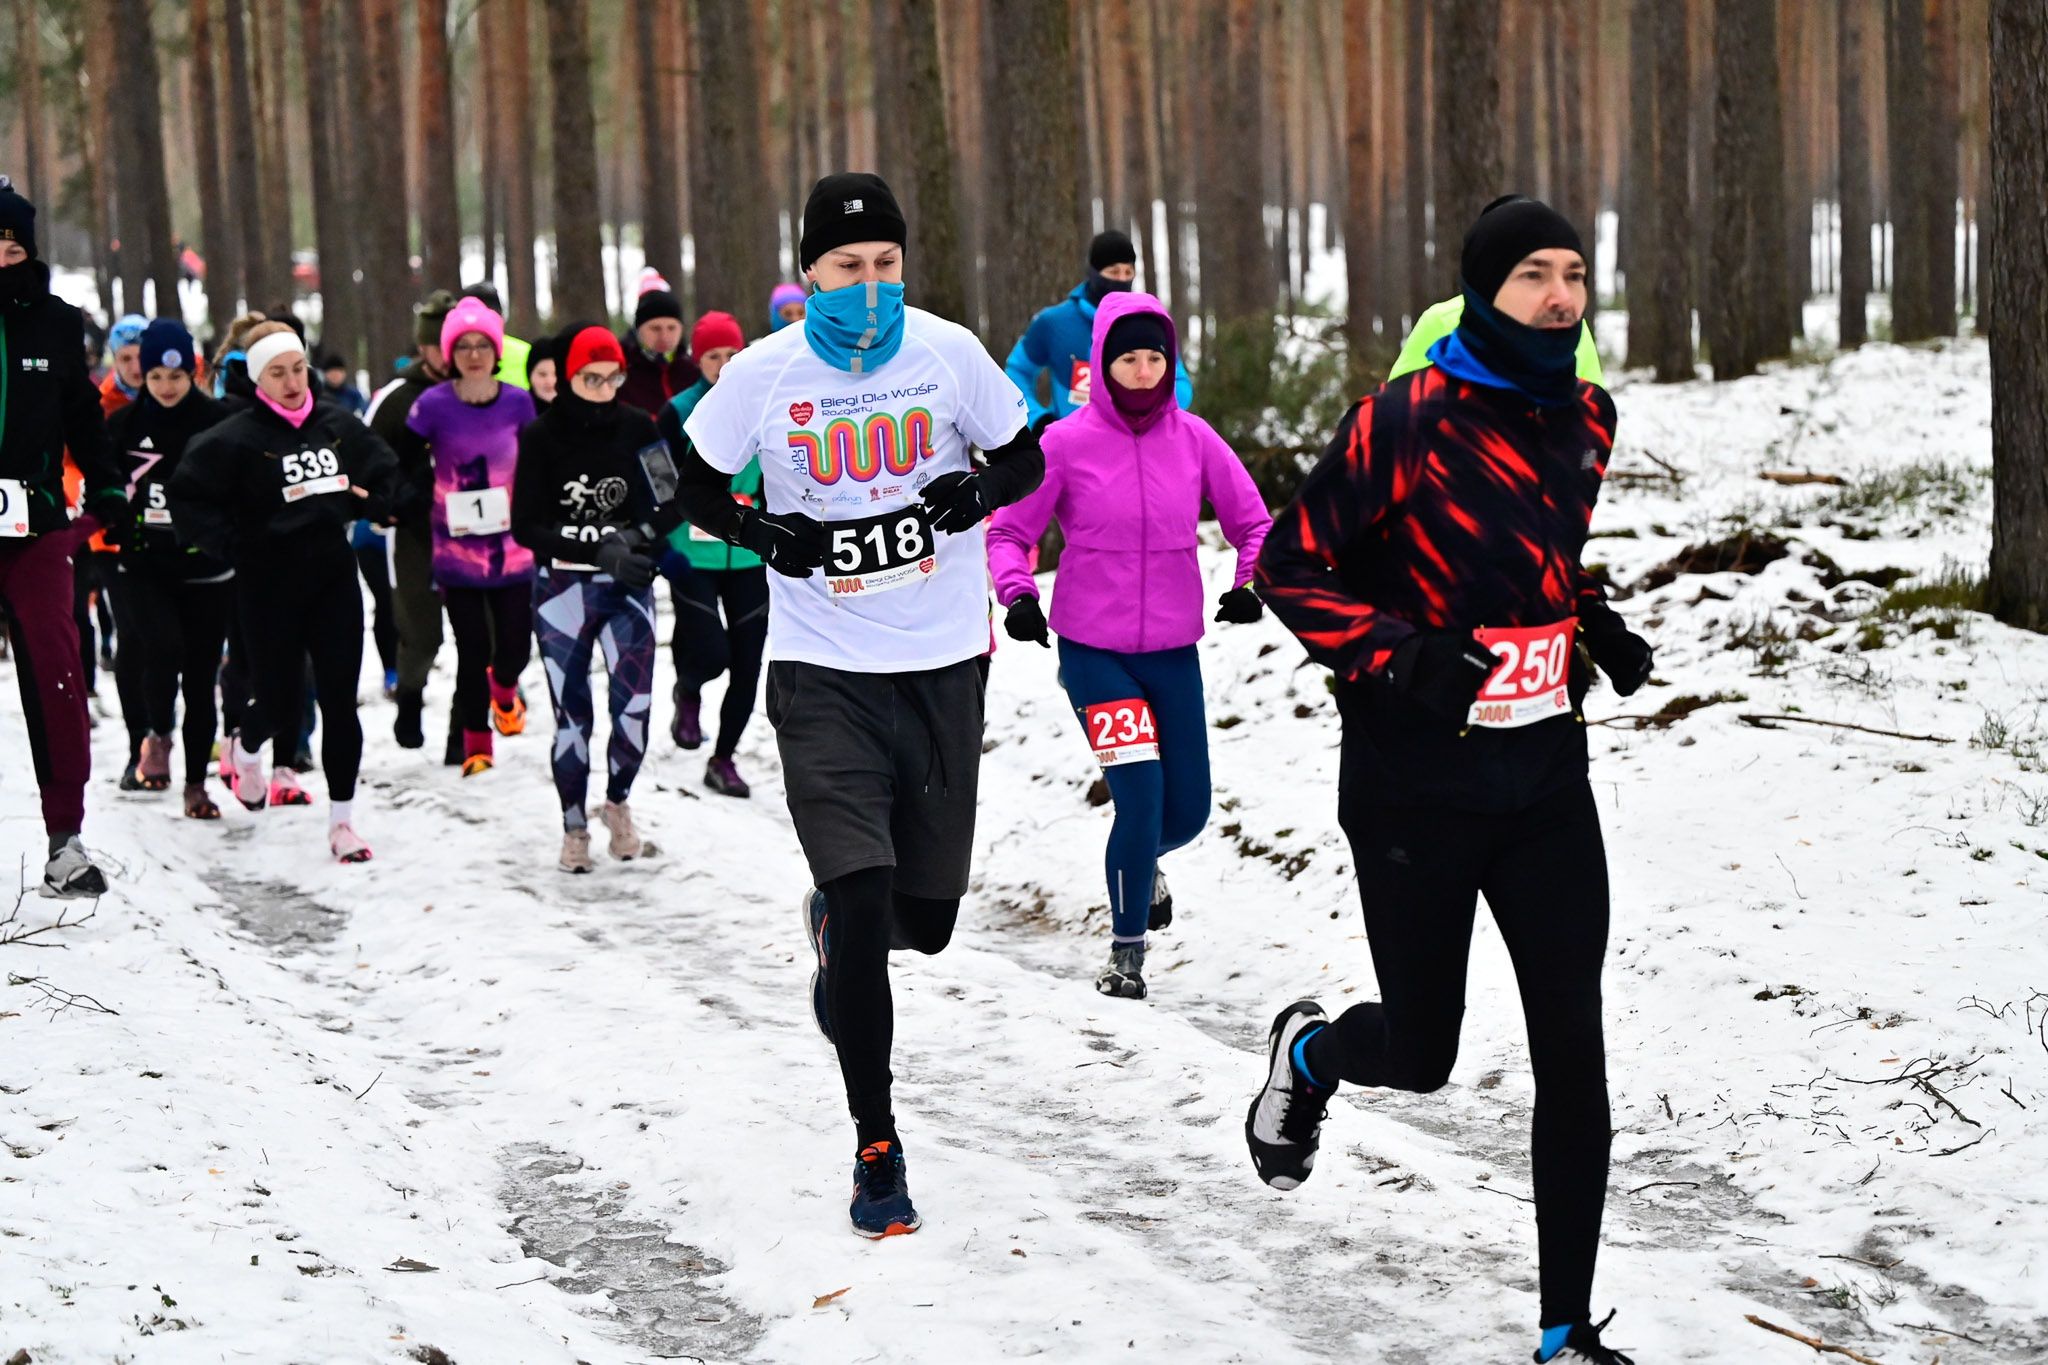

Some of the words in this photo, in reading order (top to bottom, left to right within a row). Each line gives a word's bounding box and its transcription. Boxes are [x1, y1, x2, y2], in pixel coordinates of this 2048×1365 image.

[820, 395, 859, 409] Biegi
[862, 393, 888, 404] Dla
[891, 383, 939, 399] WOŚP
[821, 406, 873, 417] Rozgarty
[282, 447, 339, 484] 539
[472, 496, 484, 519] 1
[832, 516, 924, 573] 518
[1484, 632, 1567, 697] 250
[1093, 706, 1155, 747] 234
